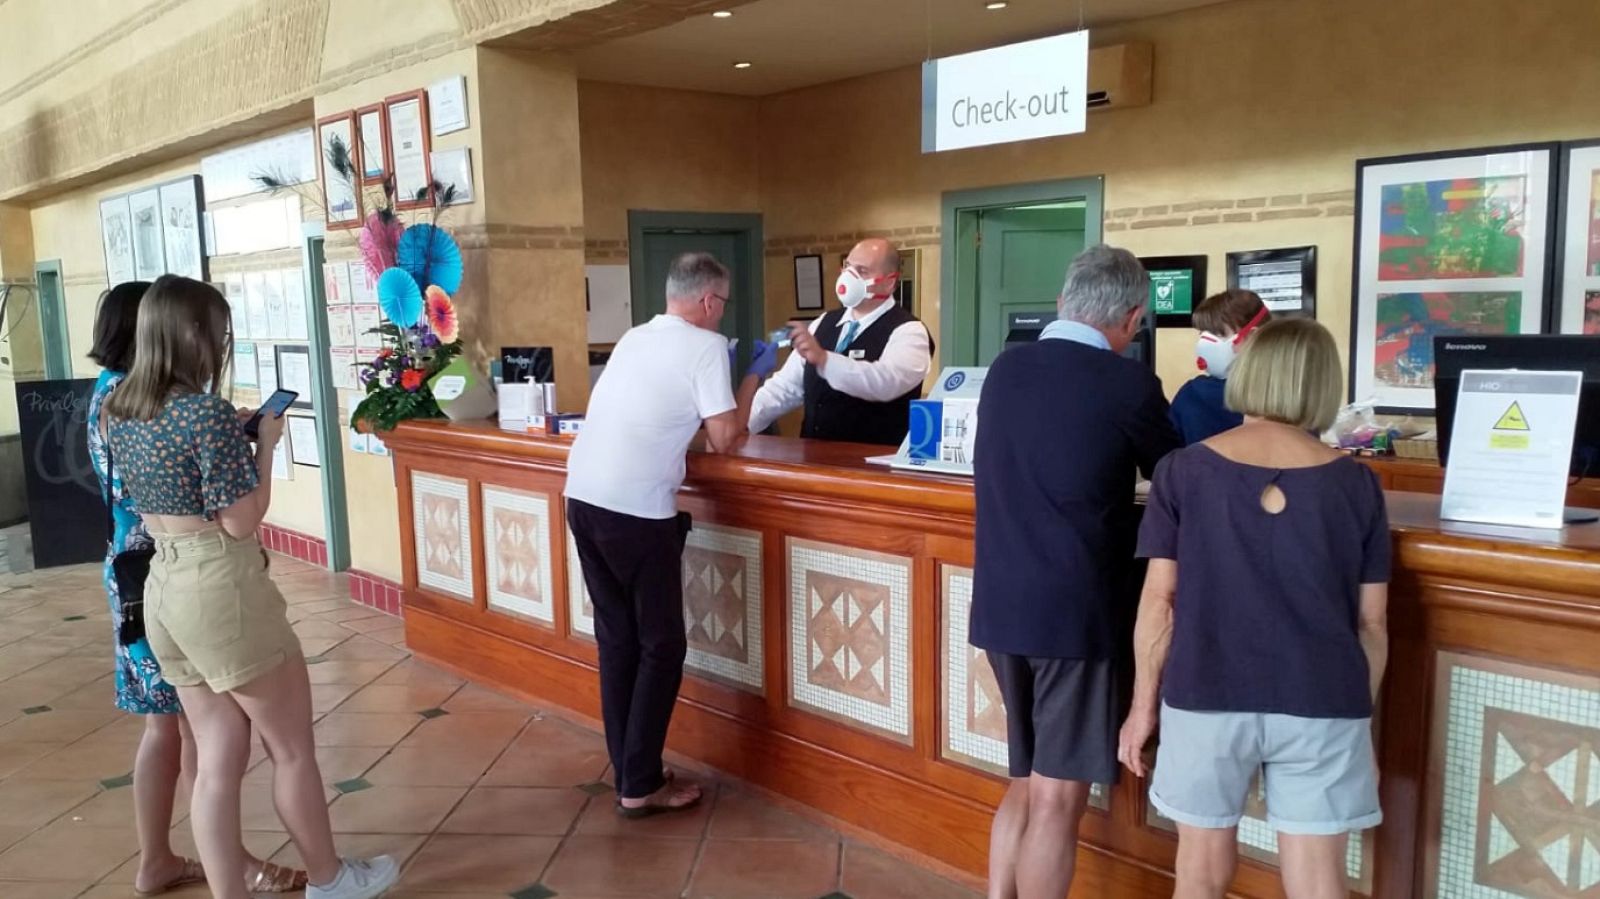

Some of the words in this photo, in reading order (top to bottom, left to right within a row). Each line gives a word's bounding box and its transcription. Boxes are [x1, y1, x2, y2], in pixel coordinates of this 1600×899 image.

[952, 85, 1069, 128] Check-out
[1445, 342, 1487, 350] lenovo
[22, 390, 88, 423] Privileg
